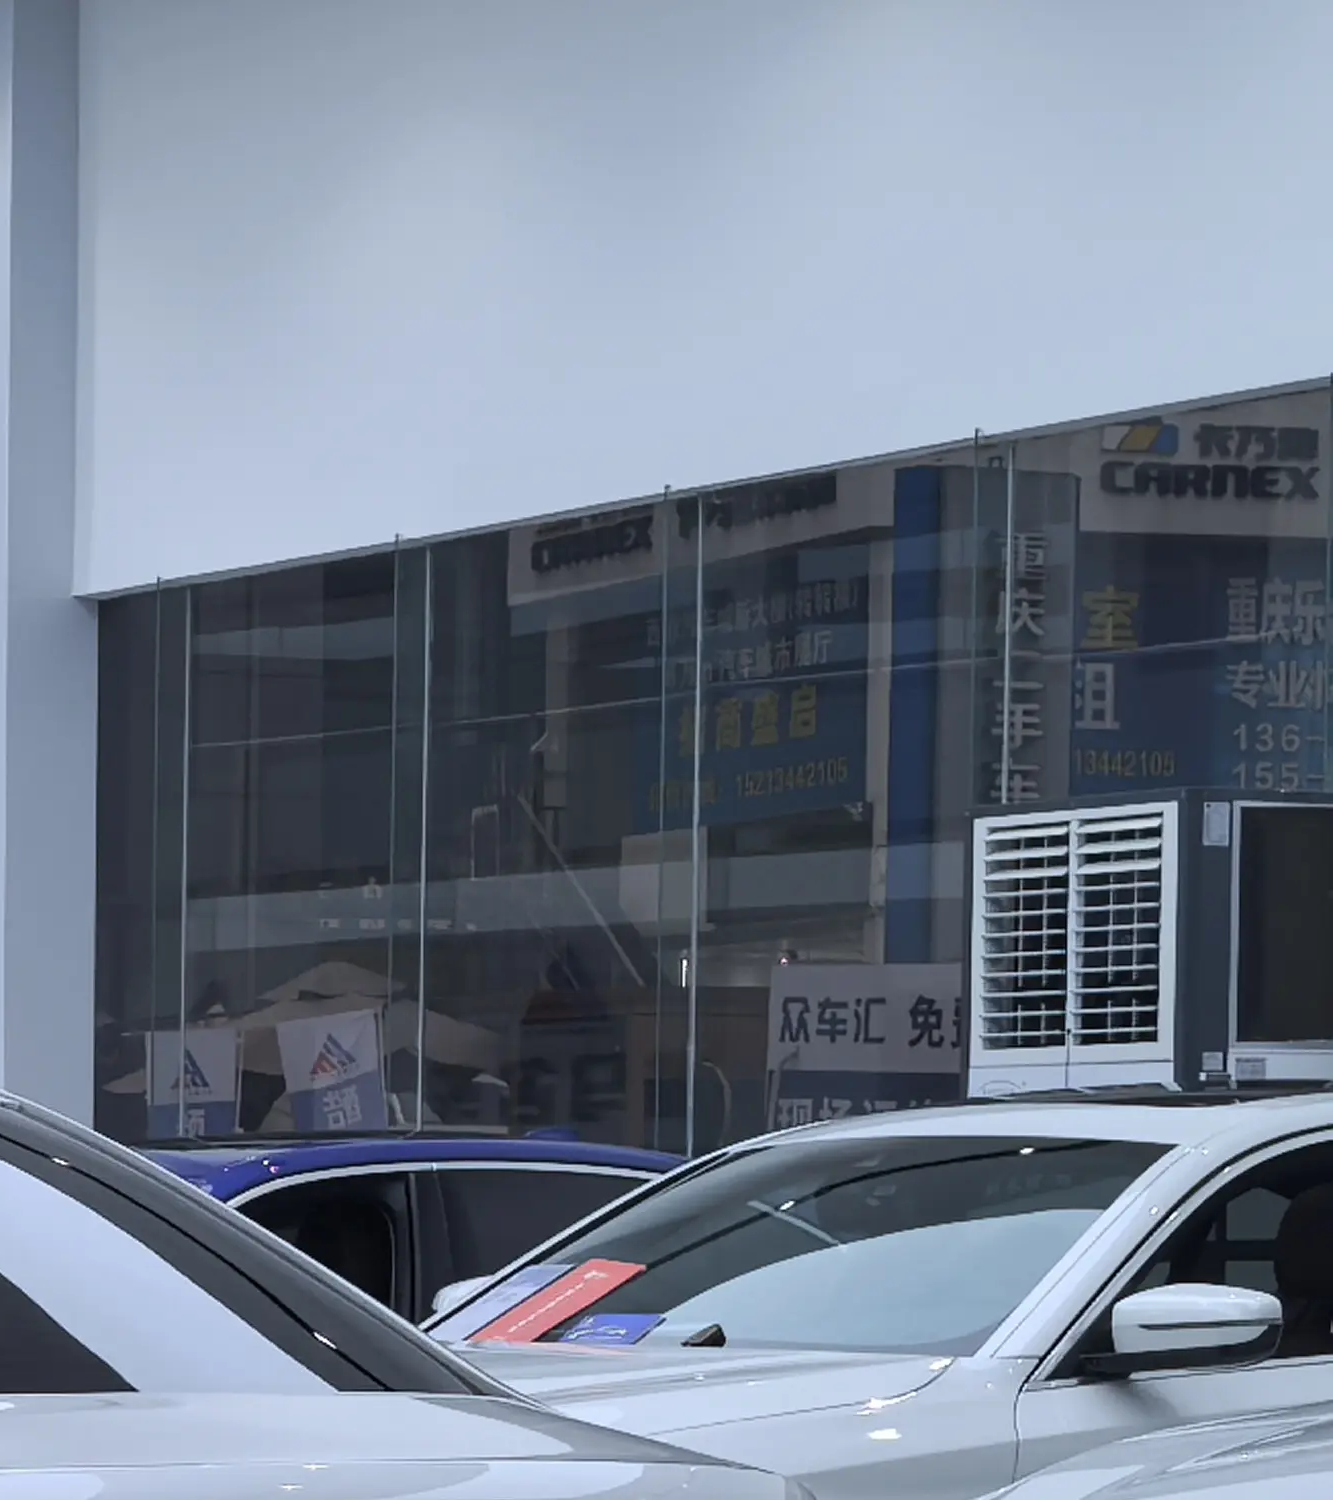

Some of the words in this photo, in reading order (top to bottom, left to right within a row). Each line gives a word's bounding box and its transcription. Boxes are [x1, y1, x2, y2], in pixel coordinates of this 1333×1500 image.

[1099, 461, 1321, 499] CARNEX
[778, 995, 887, 1043] 众车汇
